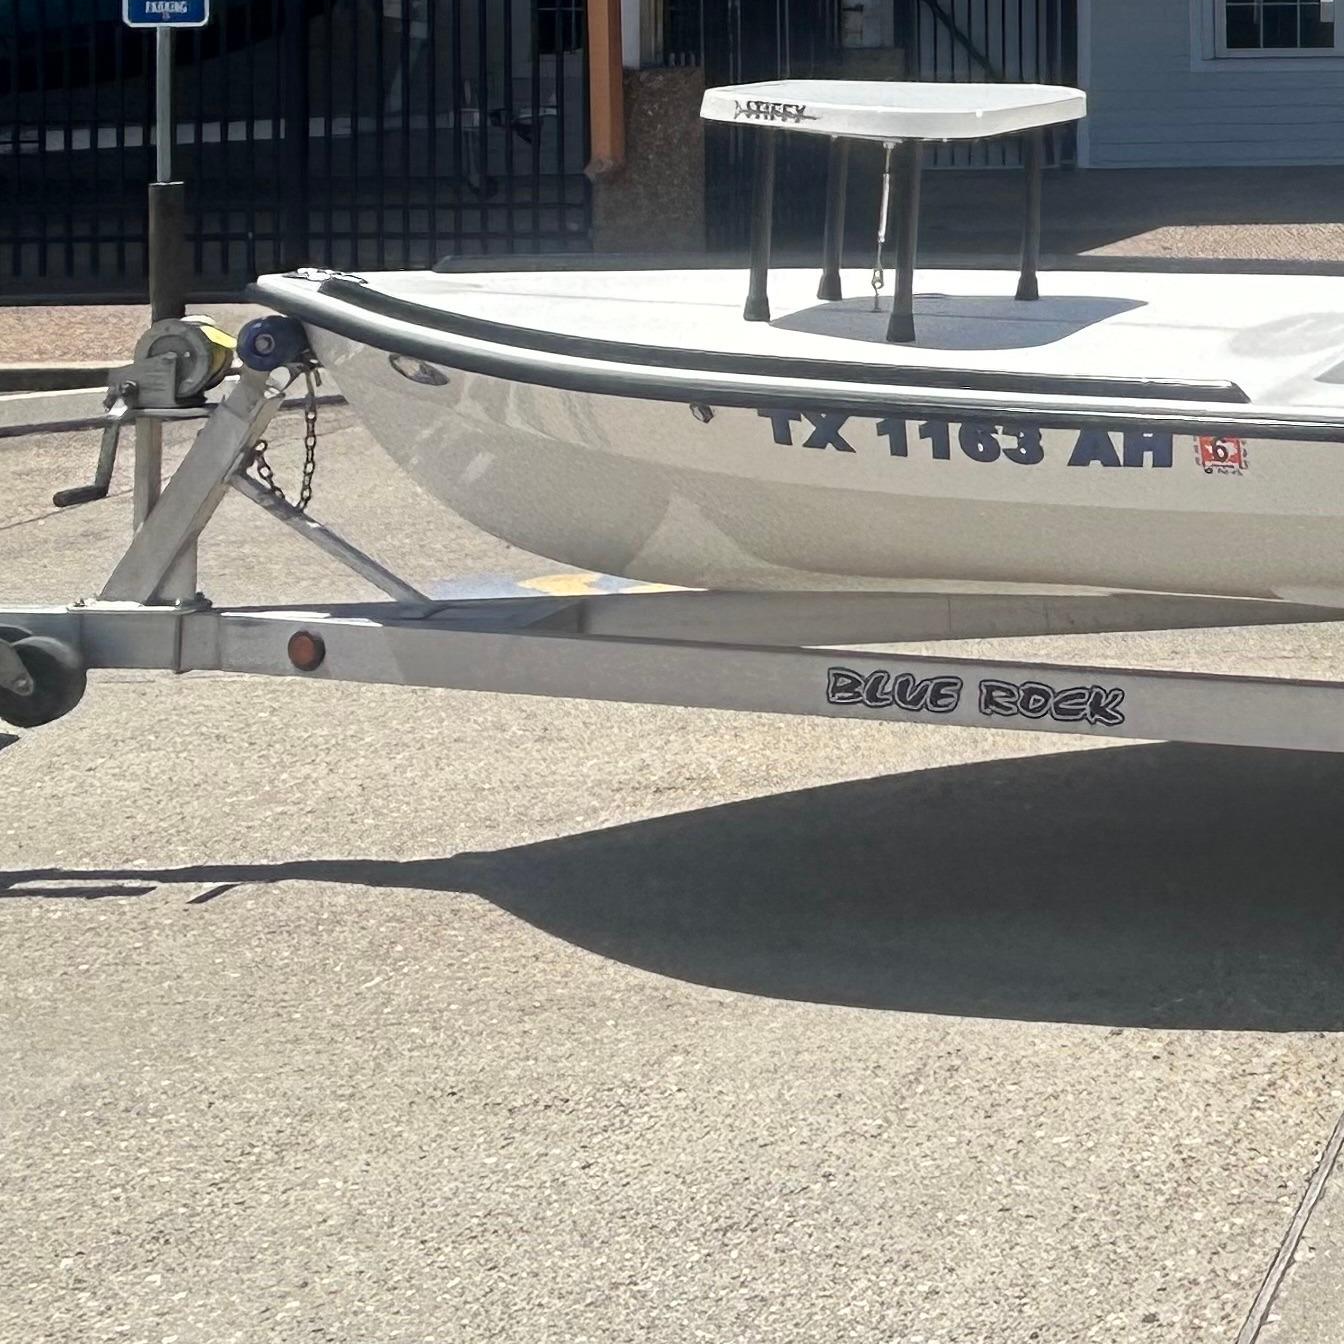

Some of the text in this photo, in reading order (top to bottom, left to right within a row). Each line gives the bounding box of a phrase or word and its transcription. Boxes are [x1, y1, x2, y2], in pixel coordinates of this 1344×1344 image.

[757, 408, 1173, 469] TX 1163 AH
[828, 667, 1125, 726] BLUE ROCK
